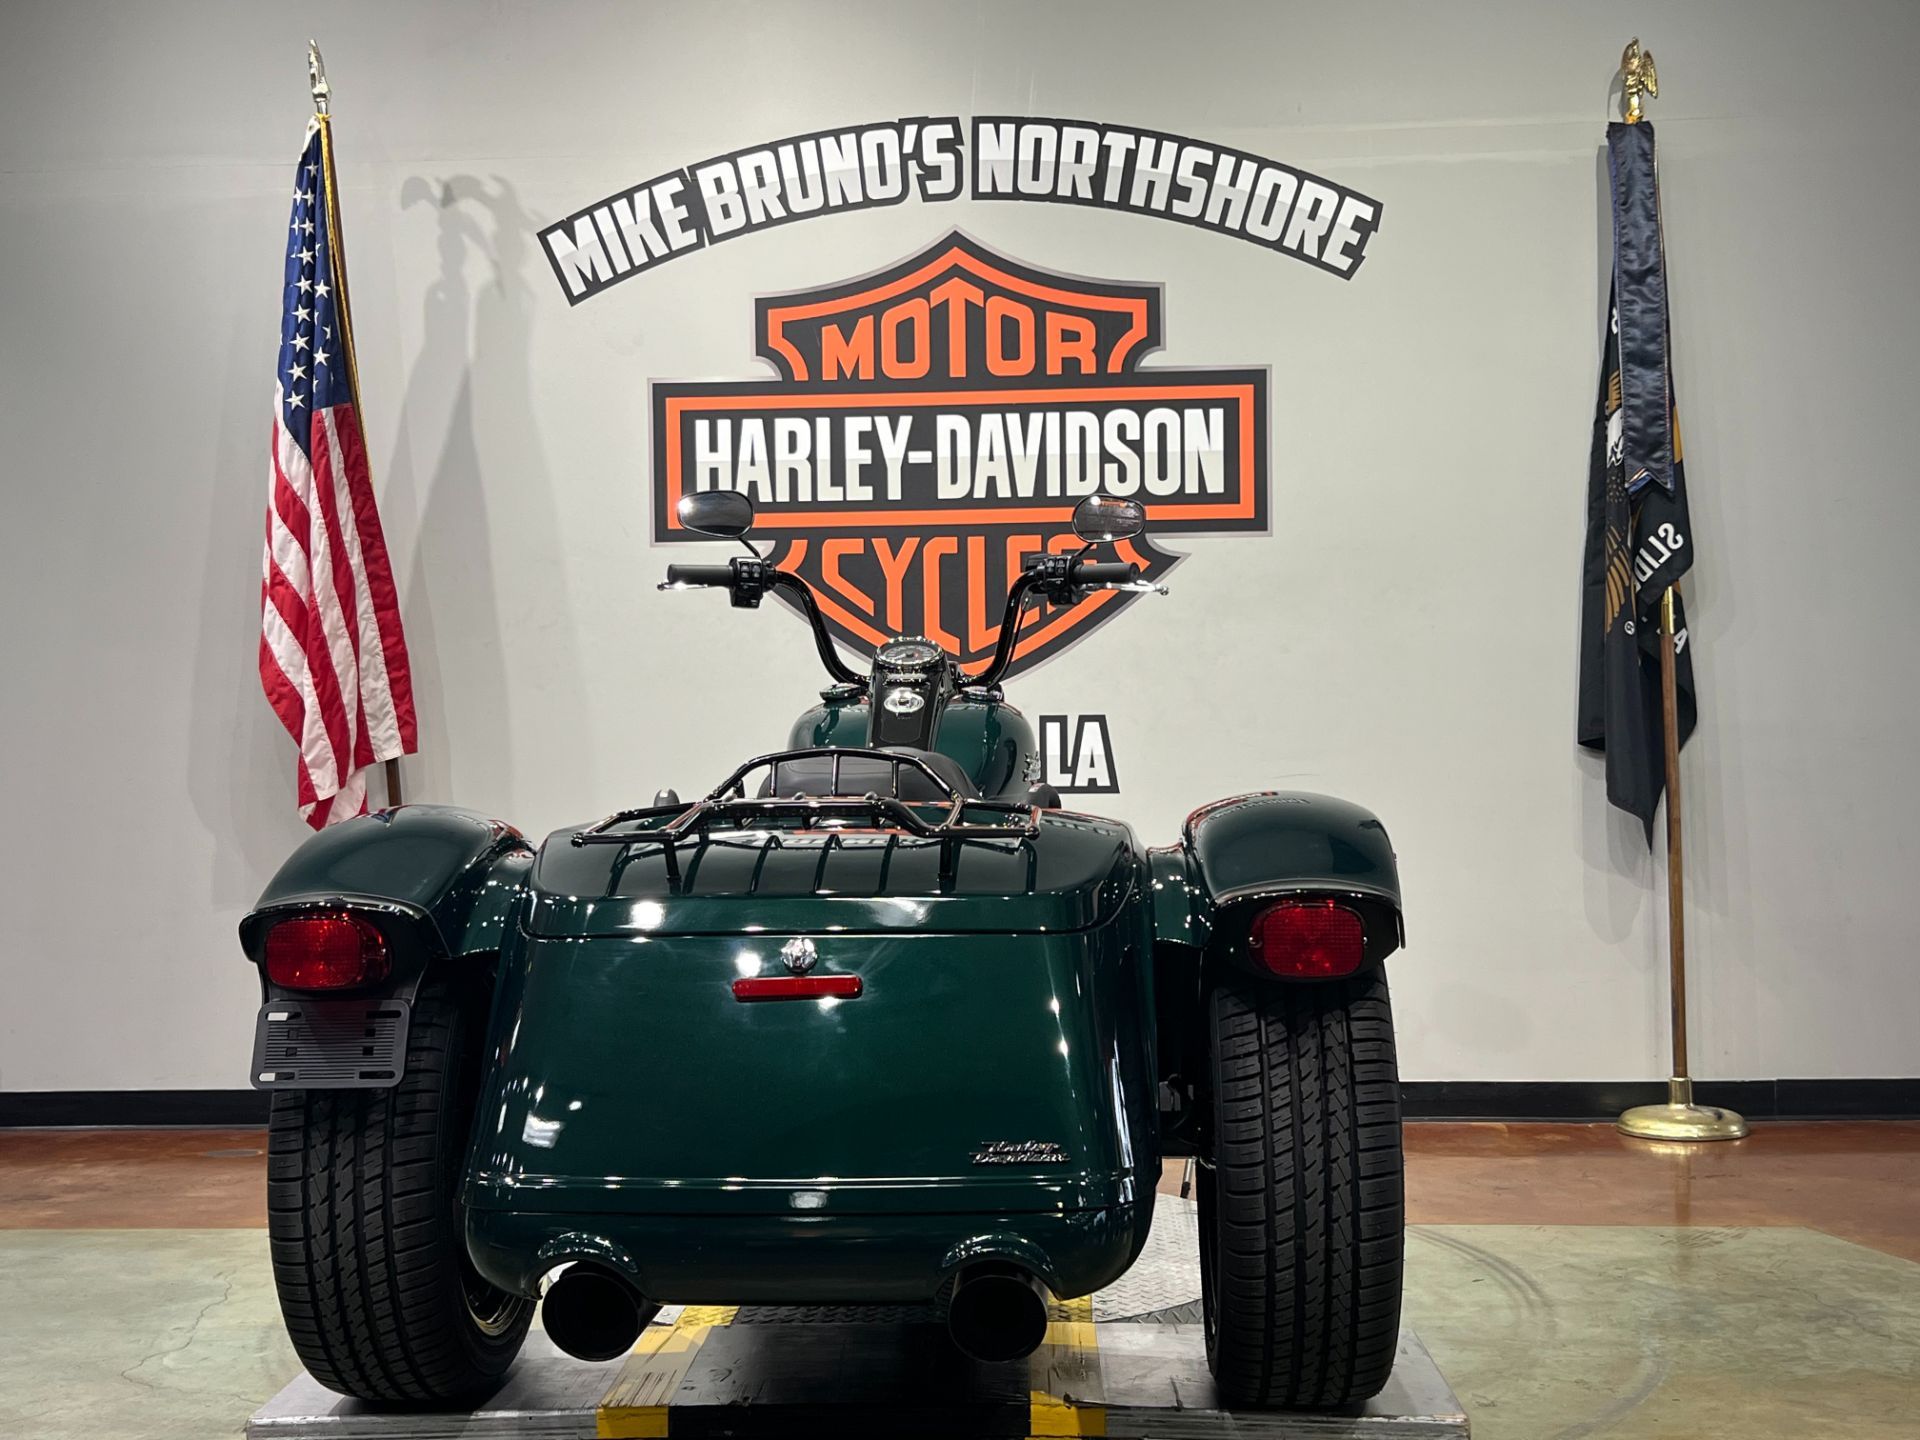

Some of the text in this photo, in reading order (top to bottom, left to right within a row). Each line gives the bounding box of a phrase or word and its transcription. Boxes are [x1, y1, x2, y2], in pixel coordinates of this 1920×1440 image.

[546, 123, 1374, 297] MIKE BRUNO'S NORTHSHORE
[821, 276, 1097, 381] MOTOR
[694, 407, 1225, 503] HARLEY-DAVIDSON
[1045, 721, 1112, 787] LA
